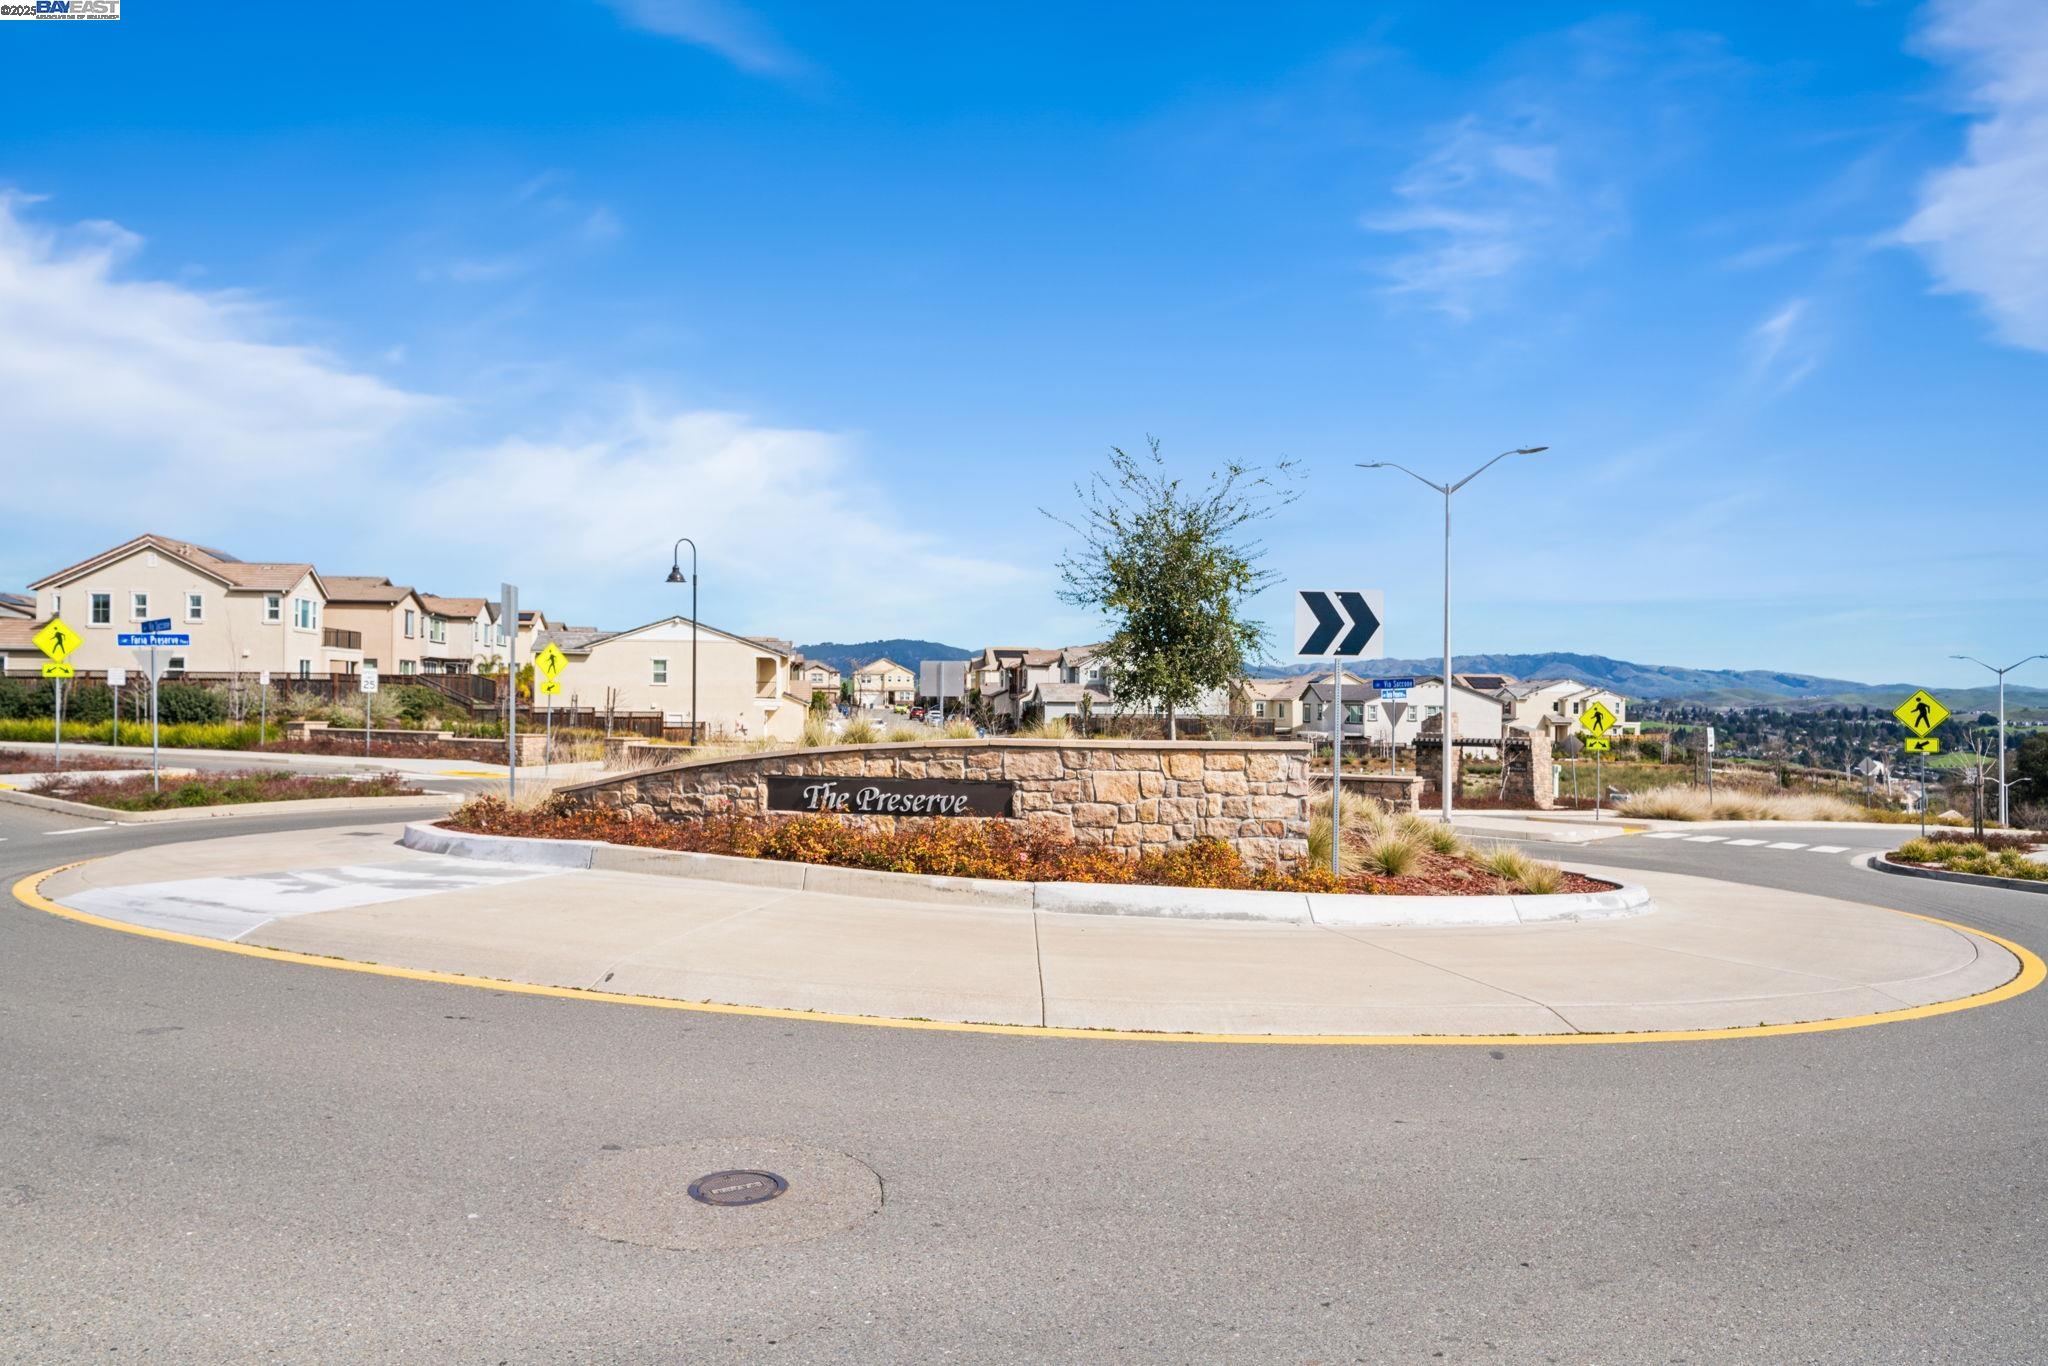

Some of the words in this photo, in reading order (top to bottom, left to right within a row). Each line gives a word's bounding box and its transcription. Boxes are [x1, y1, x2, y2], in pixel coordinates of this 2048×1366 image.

[150, 635, 178, 645] Preserve
[364, 680, 375, 689] 25
[804, 782, 849, 811] The
[856, 787, 967, 813] Preserve
